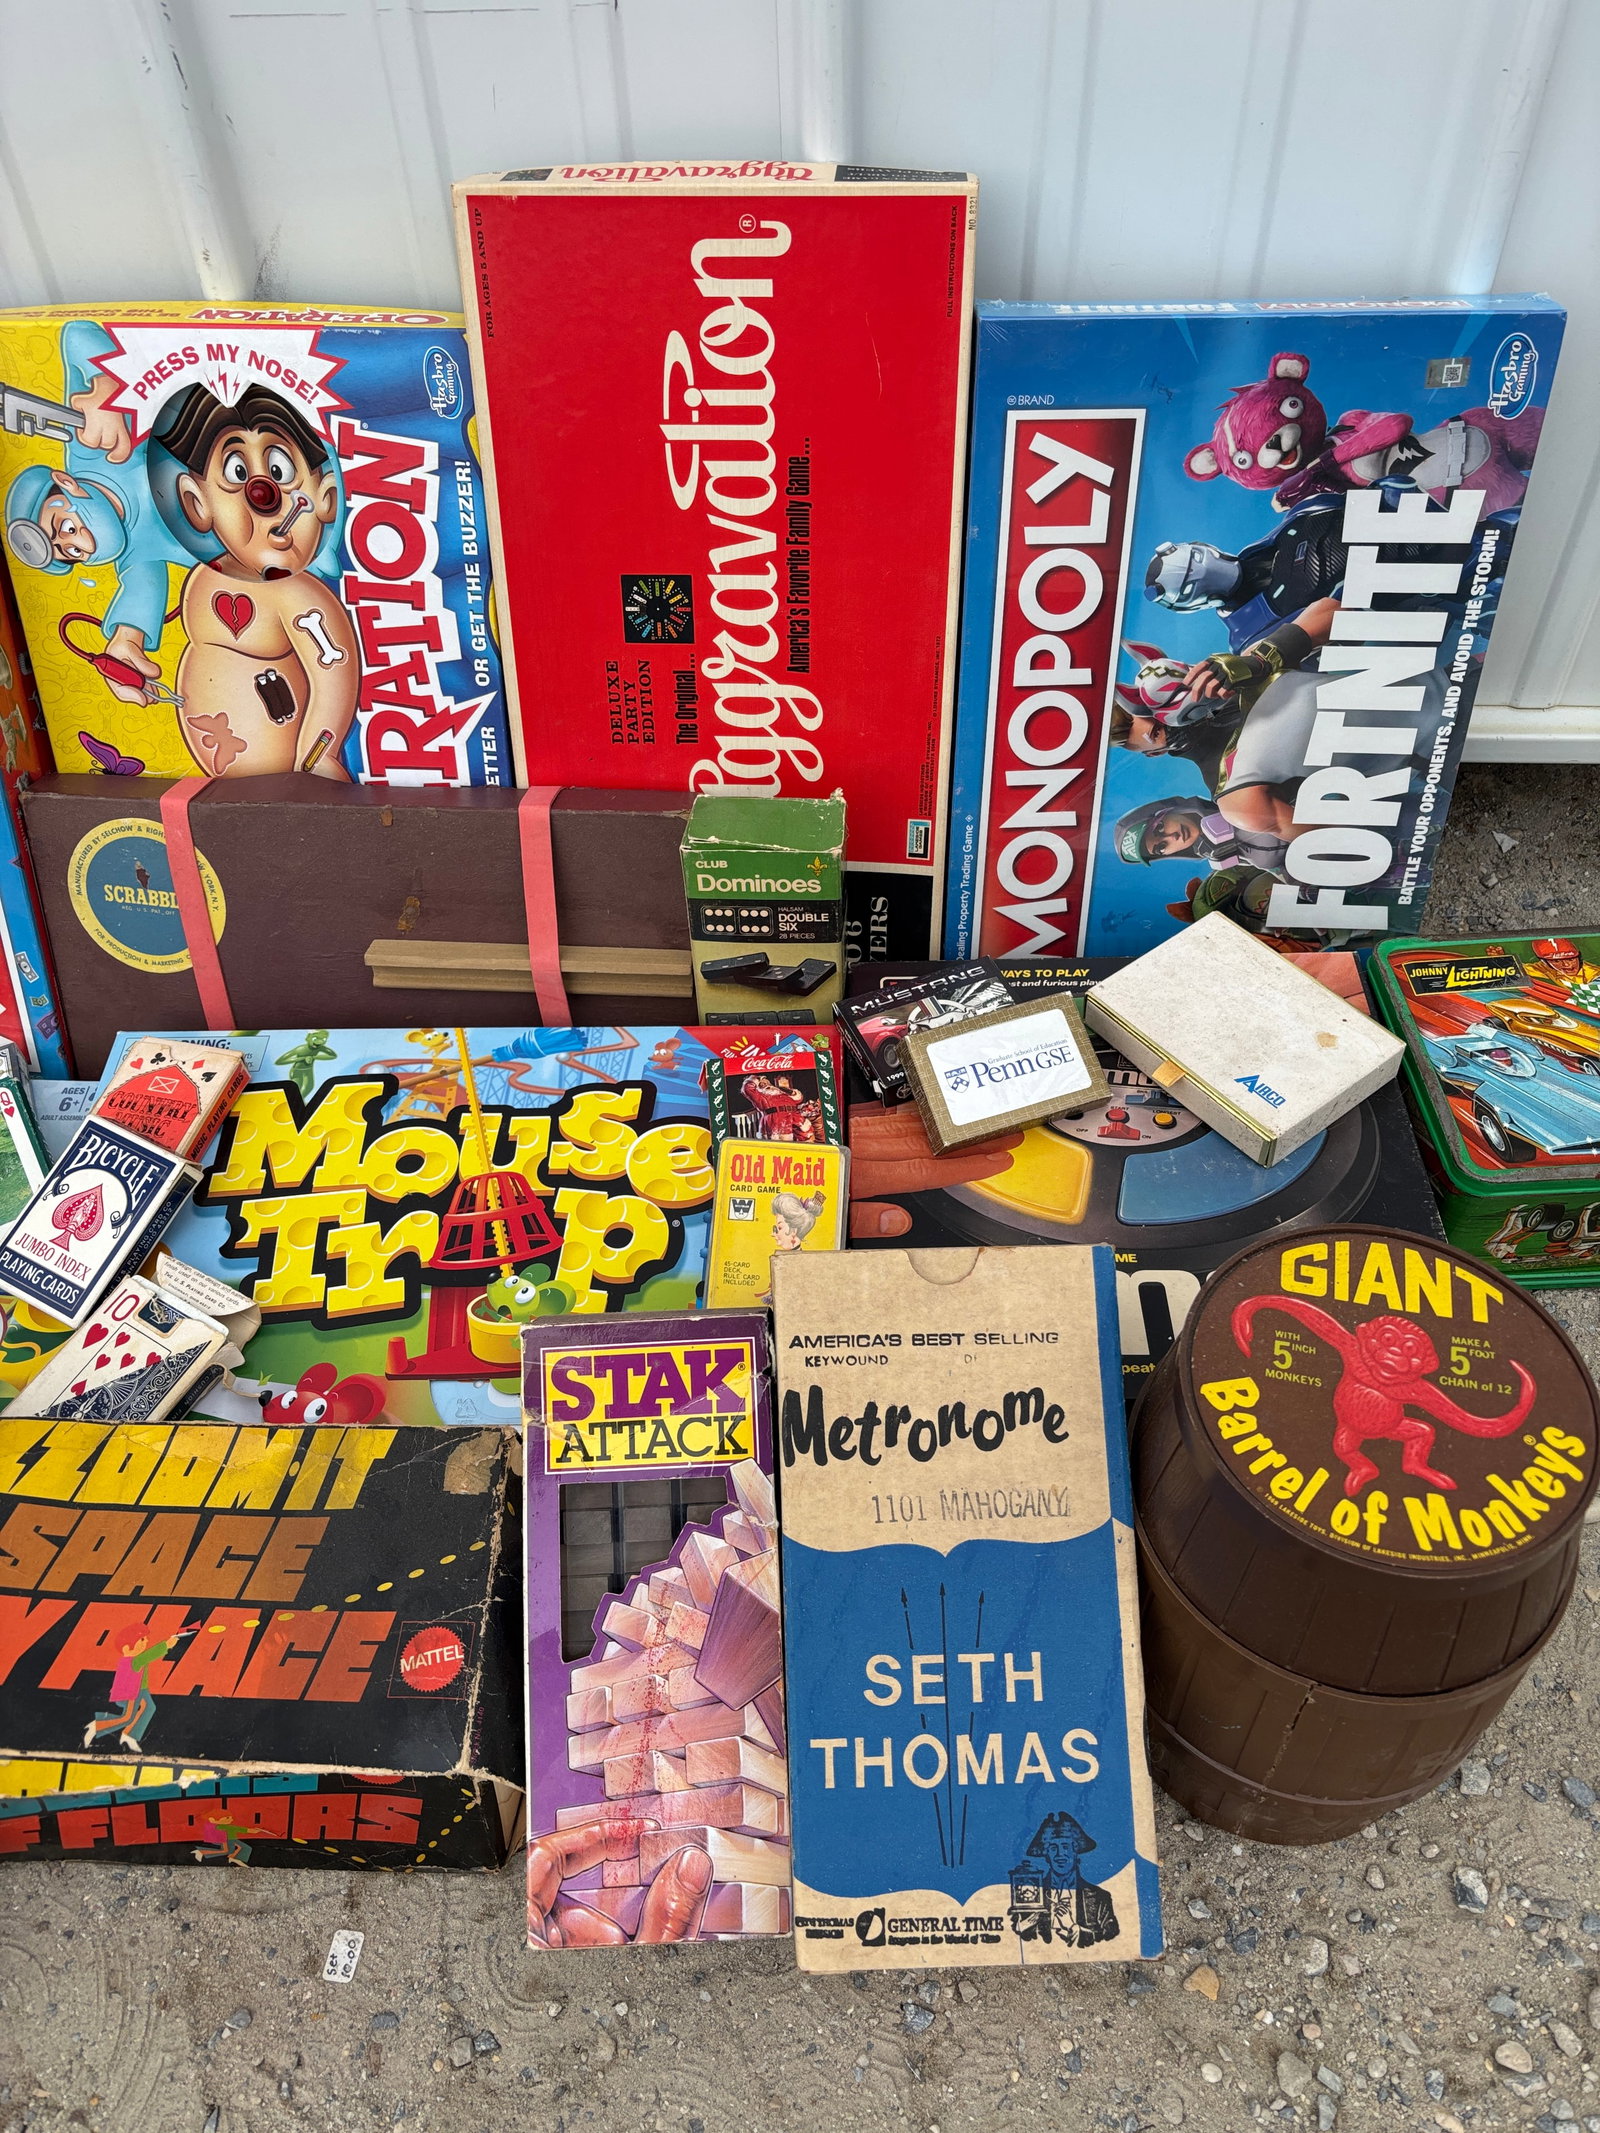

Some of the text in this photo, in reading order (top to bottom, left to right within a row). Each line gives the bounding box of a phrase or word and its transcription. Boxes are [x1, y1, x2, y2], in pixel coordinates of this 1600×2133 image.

[950, 229, 957, 241] ON
[474, 208, 495, 338] FOR AGES 5 AND UP
[948, 242, 957, 300] INSTRUCTIONS
[195, 308, 448, 325] OPERATION
[134, 343, 323, 405] PRESS MY NOSE!
[429, 352, 449, 417] Hasbro
[444, 361, 459, 404] Gaming
[1489, 338, 1523, 415] Hasbro
[1509, 350, 1534, 402] Gaming
[1017, 394, 1055, 406] BRAND
[785, 500, 813, 545] Family
[786, 548, 811, 604] Favorite
[338, 421, 483, 788] RATION
[454, 460, 501, 788] ETTER OR GET THE BUZZER!
[786, 607, 811, 674] America's
[606, 660, 625, 745] DELUXE
[638, 659, 656, 745] EDITION
[993, 431, 1115, 959] MONOPOLY
[1265, 488, 1488, 931] FORTNITE
[623, 680, 640, 745] PARTY
[1398, 528, 1502, 906] BATTLE YOUR OPPONENTS, AND AVOID THE STORM!
[675, 723, 699, 745] The
[963, 824, 974, 853] Game
[75, 844, 93, 895] MANUFACTURED
[93, 837, 102, 845] BY
[101, 825, 133, 839] SELCHOW
[695, 860, 729, 869] CLUB
[960, 854, 974, 888] Trading
[103, 884, 181, 909] SCRABBL
[696, 874, 822, 893] Dominoes
[778, 913, 830, 922] DOUBLE
[958, 889, 971, 929] Property
[778, 923, 799, 932] SIX
[789, 932, 816, 940] PIECES
[94, 928, 106, 940] FOR
[105, 939, 142, 962] PRODUCTION
[1035, 969, 1052, 978] TO
[1055, 968, 1090, 978] PLAY
[1039, 979, 1076, 987] furious
[1409, 967, 1449, 978] JOHNNY
[1446, 966, 1516, 988] LIGHTNING
[850, 966, 986, 1015] MUSTANG
[741, 1054, 794, 1072] Coca-Cola
[987, 1052, 1013, 1065] Graduate
[1014, 1047, 1032, 1059] School
[1040, 1039, 1068, 1051] Education
[60, 1087, 86, 1095] AGES
[886, 1071, 905, 1083] 1999
[1233, 1074, 1287, 1108] AIRCO
[58, 1097, 80, 1112] 6+
[109, 1090, 198, 1123] COUNTRY
[190, 1073, 245, 1161] MUSIC PLAYING CARDS
[115, 1111, 173, 1138] MUSIC
[208, 1081, 716, 1206] Mouse
[64, 1134, 159, 1210] BICYCLE
[730, 1153, 825, 1187] Old Maid
[730, 1184, 781, 1194] CARD GAME
[15, 1233, 92, 1282] JUMBO INDEX
[1115, 1253, 1138, 1263] ME
[0, 1251, 80, 1303] PLAYING CARDS
[722, 1279, 756, 1287] INCLUDED
[1280, 1240, 1504, 1324] GIANT
[103, 1288, 141, 1321] 10
[789, 1332, 1060, 1349] AMERICA'S BEST SELLING
[1274, 1330, 1301, 1341] WITH
[1451, 1335, 1491, 1348] MAKE A
[805, 1354, 889, 1368] KEYWOUND
[1121, 1362, 1156, 1375] peat
[1272, 1341, 1317, 1370] 5 INCH
[1449, 1347, 1496, 1376] 5 FOOT
[551, 1348, 746, 1422] STAK
[1264, 1368, 1323, 1388] MONKEYS
[1438, 1375, 1512, 1396] CHAIN of 12
[555, 1415, 749, 1464] ATTACK
[782, 1384, 1070, 1468] Metronome
[1200, 1376, 1587, 1552] Barrel of Monkeys
[871, 1486, 1071, 1524] 1101 MAHOGANY
[1279, 1504, 1309, 1526] LAKESIDE
[1329, 1532, 1361, 1548] DIVISION
[1373, 1546, 1407, 1559] LAKESIDE
[0, 1503, 330, 1601] SPACE
[400, 1645, 465, 1673] MATTEL
[863, 1651, 1043, 1706] SETH
[810, 1728, 1100, 1790] THOMAS
[57, 1793, 423, 1850] FLOORS
[888, 1916, 1004, 1933] GENERAL TIME
[326, 1953, 338, 1976] Set
